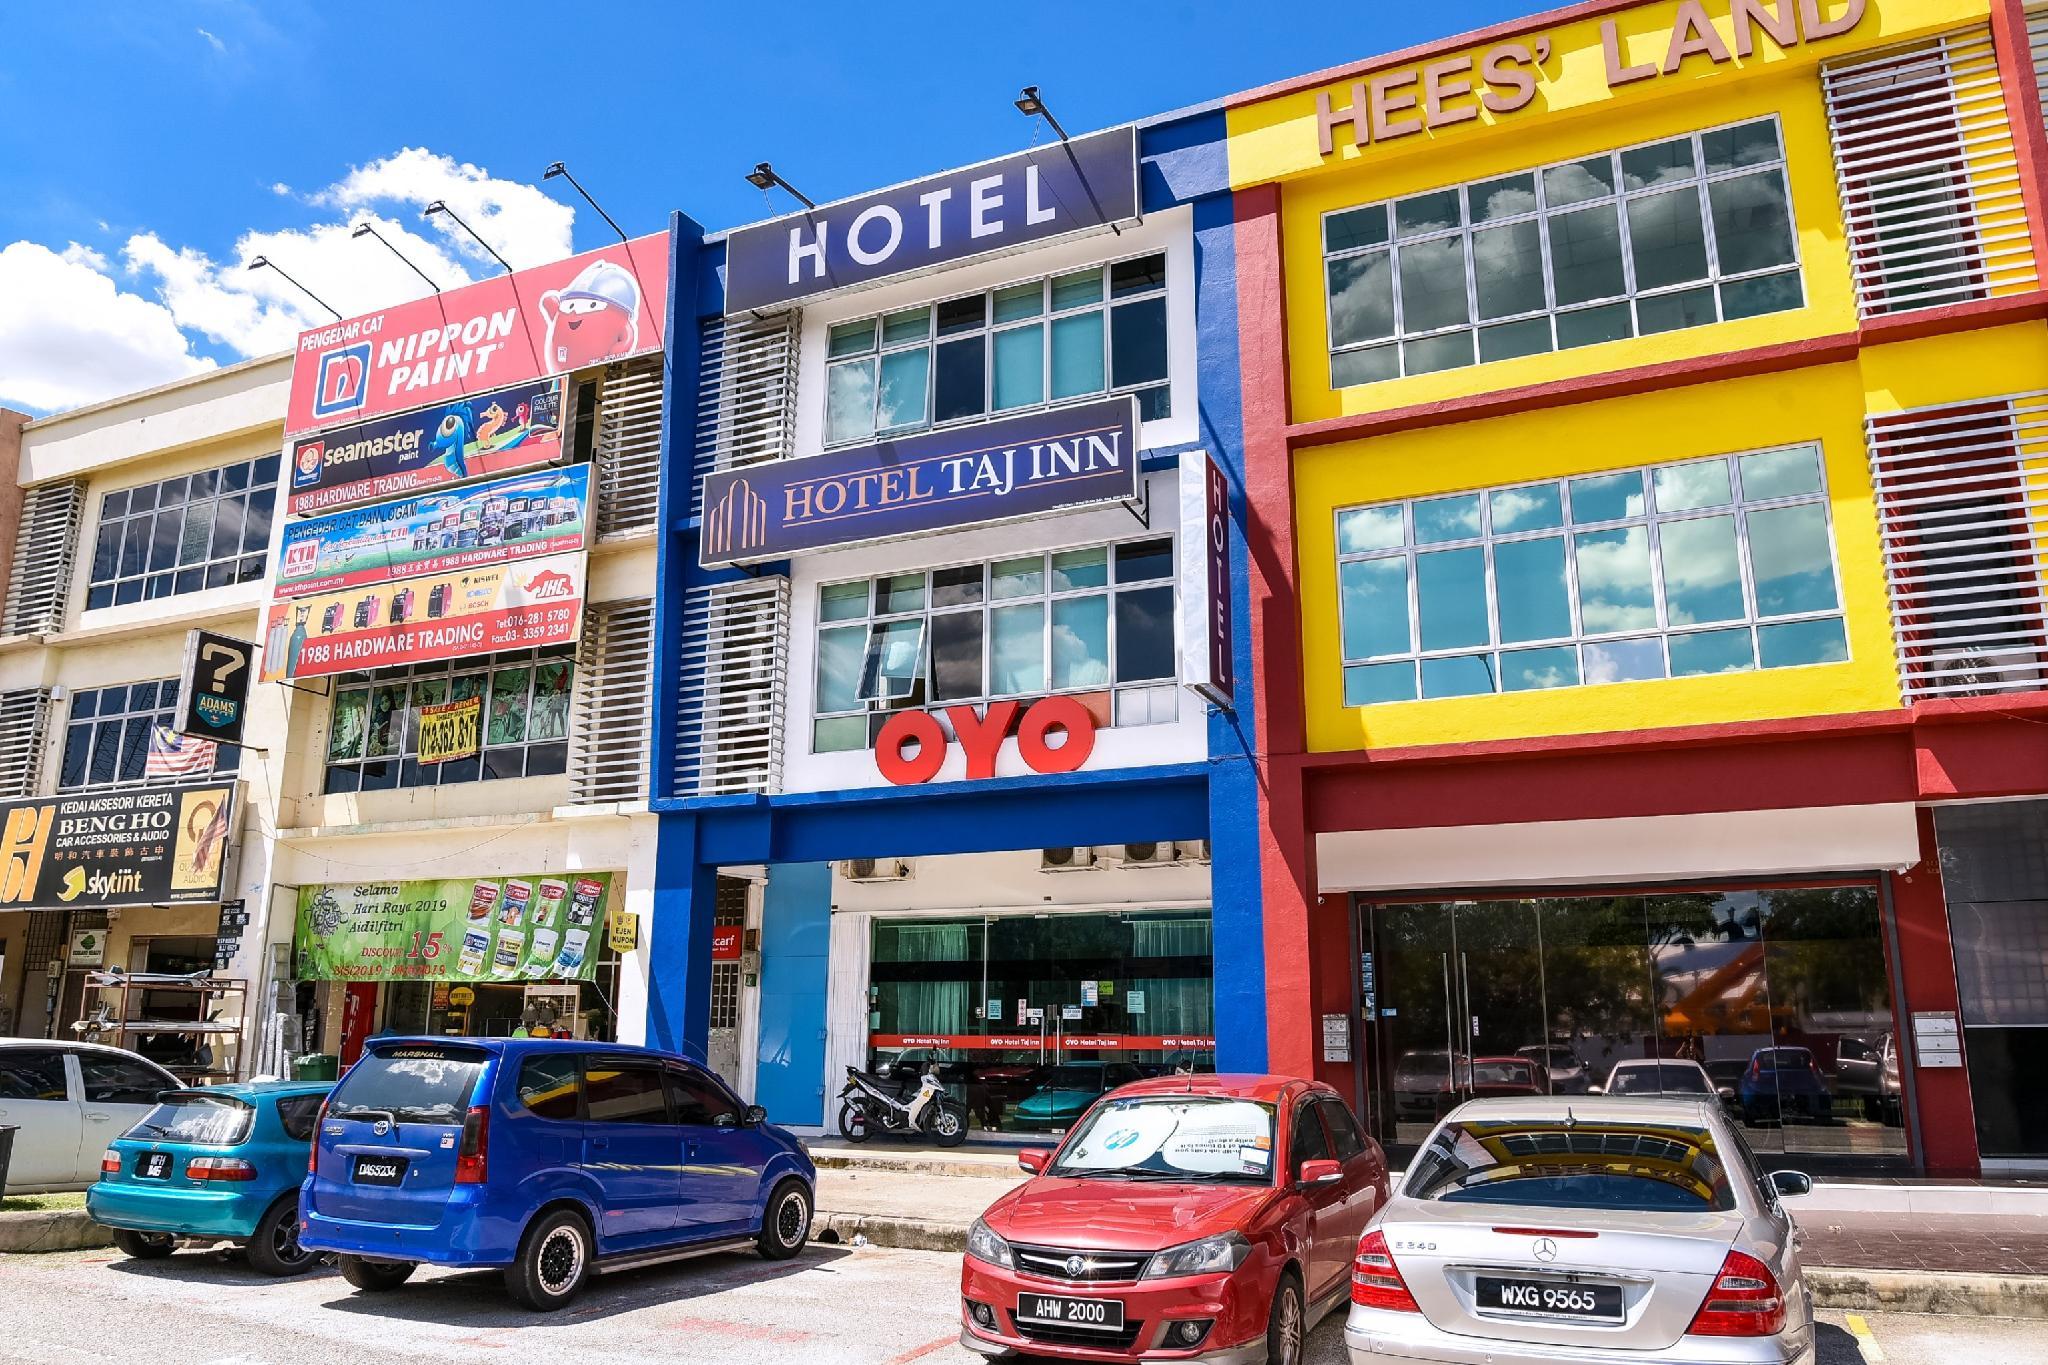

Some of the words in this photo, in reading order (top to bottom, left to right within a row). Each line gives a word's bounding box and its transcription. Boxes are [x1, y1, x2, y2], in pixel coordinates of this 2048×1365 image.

[1602, 0, 1867, 88] LAND
[788, 164, 1056, 285] HOTEL
[300, 322, 360, 353] PENGEDAR
[362, 315, 384, 336] CAT
[377, 308, 517, 368] NIPPON
[387, 345, 498, 395] PAINT
[534, 395, 558, 405] COLOUR
[324, 427, 424, 468] seamaster
[399, 450, 420, 464] paint
[782, 467, 934, 522] HOTEL
[941, 449, 1017, 496] TAJ
[1028, 431, 1123, 482] INN
[295, 494, 313, 512] 1988
[316, 481, 370, 507] HARDWARE
[373, 473, 417, 494] TRADING
[288, 518, 337, 540] PENGEDAR
[339, 514, 358, 531] CAT
[359, 508, 379, 527] DAN
[380, 501, 418, 523] LOGAM
[442, 555, 459, 566] 1988
[462, 548, 508, 564] HARDWARE
[510, 541, 548, 555] TRADING
[1213, 470, 1225, 684] HOTEL
[547, 608, 570, 622] 5780
[300, 644, 330, 665] 1988
[333, 632, 415, 660] HARDWARE
[418, 622, 484, 649] TRADING
[523, 626, 545, 639] 3359
[547, 623, 569, 636] 2341
[200, 696, 235, 713] ADAMS
[875, 696, 1096, 785] OYO
[61, 800, 88, 814] KEDAI
[88, 796, 135, 813] AKSESORI
[136, 793, 173, 808] KERETA
[57, 814, 127, 835] BENG
[129, 811, 172, 830] HO
[56, 836, 73, 848] CAR
[74, 832, 133, 846] ACCESSORIES
[133, 832, 140, 841] &
[140, 830, 170, 841] AUDIO
[352, 903, 379, 915] Hari
[382, 901, 411, 916] Raya
[415, 899, 447, 912] 2019
[348, 920, 404, 935] Aidilfitri
[612, 935, 634, 944] KUPON
[1395, 1241, 1404, 1249] E
[1407, 1241, 1437, 1250] 240
[1035, 1298, 1064, 1319] AHW
[1068, 1301, 1105, 1323] 2000
[1501, 1285, 1540, 1306] WXG
[1543, 1289, 1596, 1311] 9565
